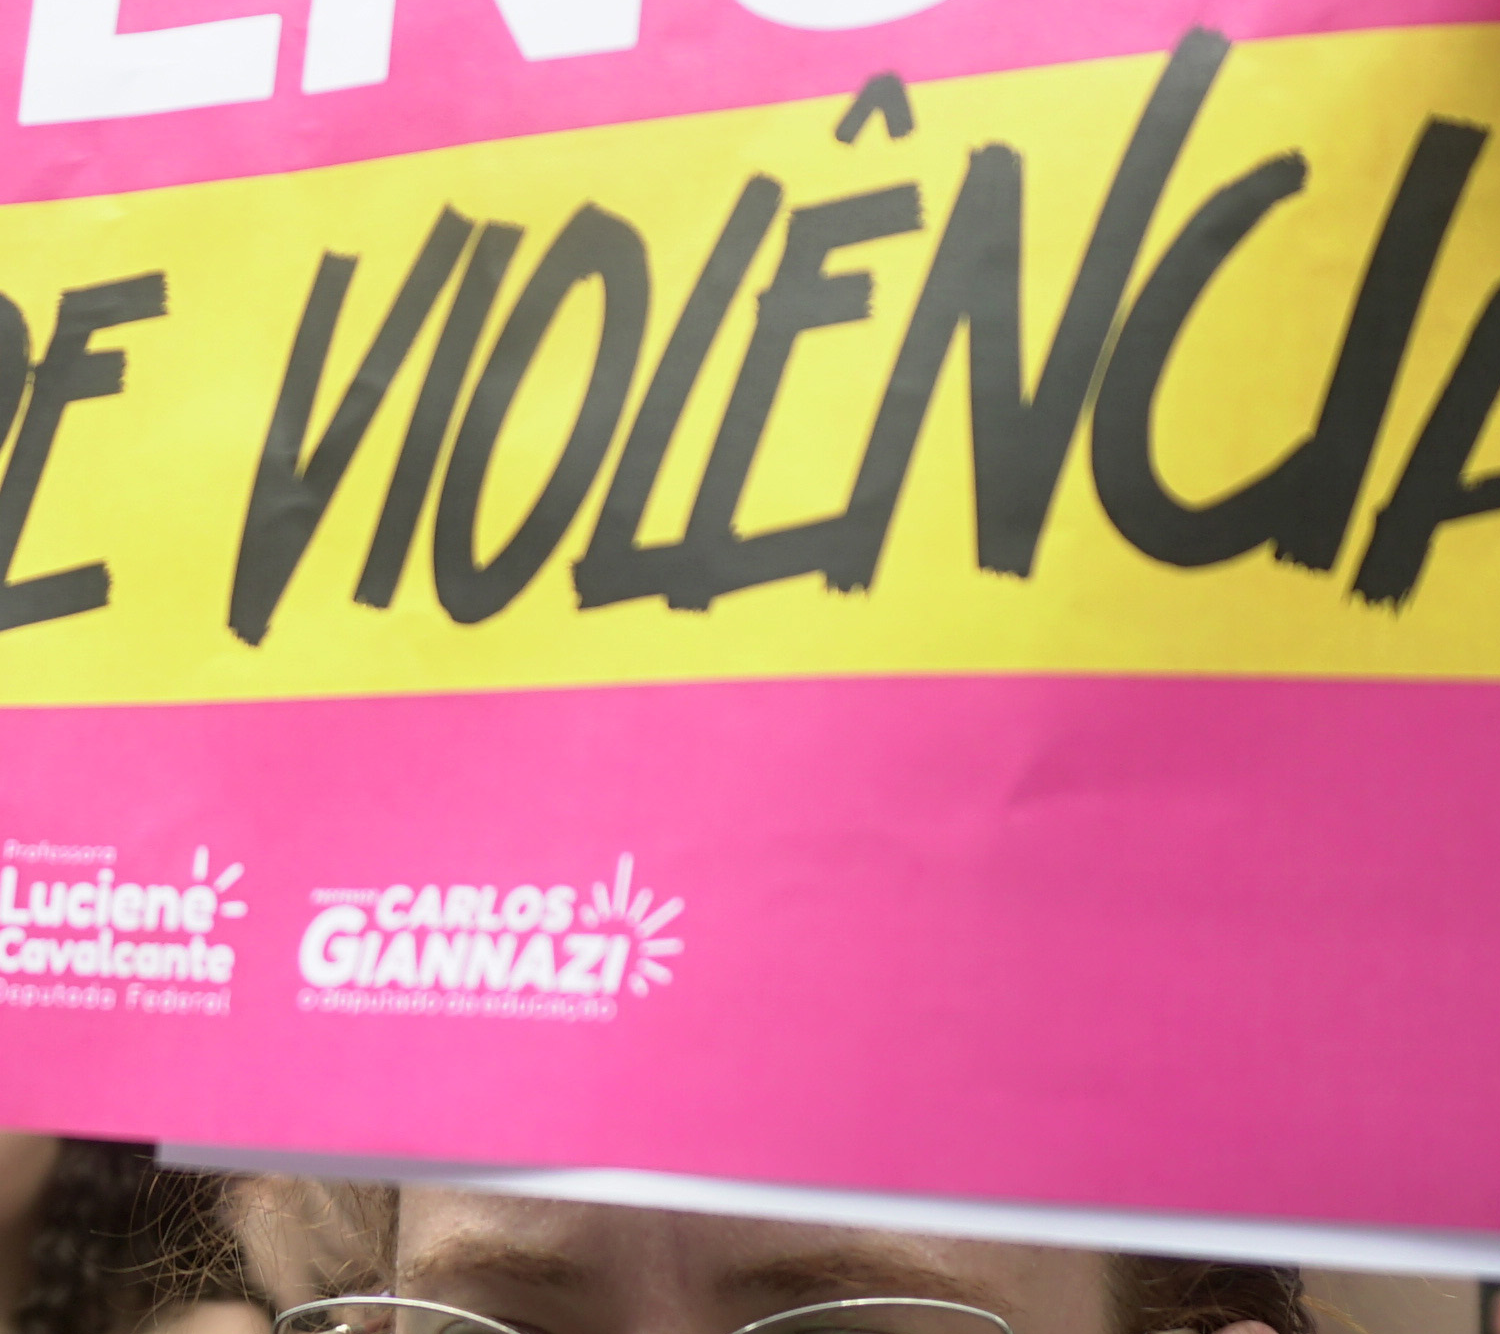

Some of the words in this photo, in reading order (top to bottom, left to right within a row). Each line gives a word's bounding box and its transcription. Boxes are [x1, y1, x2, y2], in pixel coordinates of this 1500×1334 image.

[375, 884, 577, 933] CARLOS
[298, 904, 632, 995] GIANNAZI
[125, 982, 232, 1016] Federal
